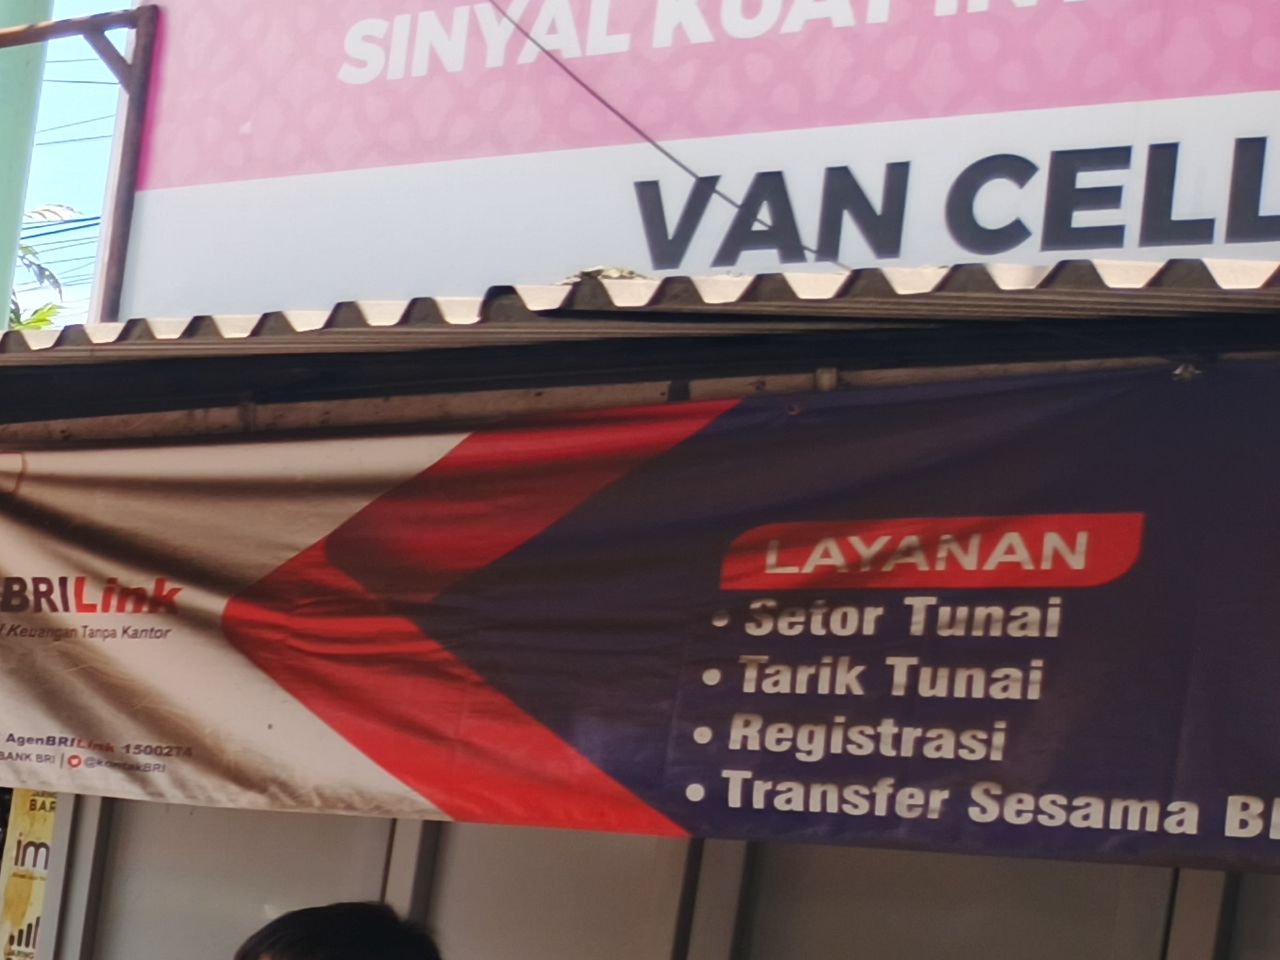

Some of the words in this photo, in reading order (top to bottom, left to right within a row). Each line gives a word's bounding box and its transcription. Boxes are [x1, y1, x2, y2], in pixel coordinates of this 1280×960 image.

[336, 0, 631, 85] SINYAL
[634, 160, 911, 271] VAN
[764, 530, 1089, 575] LAYANAN
[6, 624, 77, 642] Keuangan
[81, 625, 118, 642] Tanpa
[121, 624, 172, 640] Kantor
[744, 599, 883, 637] Setor
[904, 596, 1062, 639] Tunai
[740, 654, 867, 696] Tarik
[885, 656, 1045, 701] Tunai
[35, 753, 55, 764] BRI
[728, 713, 1007, 763] Registrasi
[720, 769, 948, 821] Transfer
[967, 782, 1200, 836] Sesama
